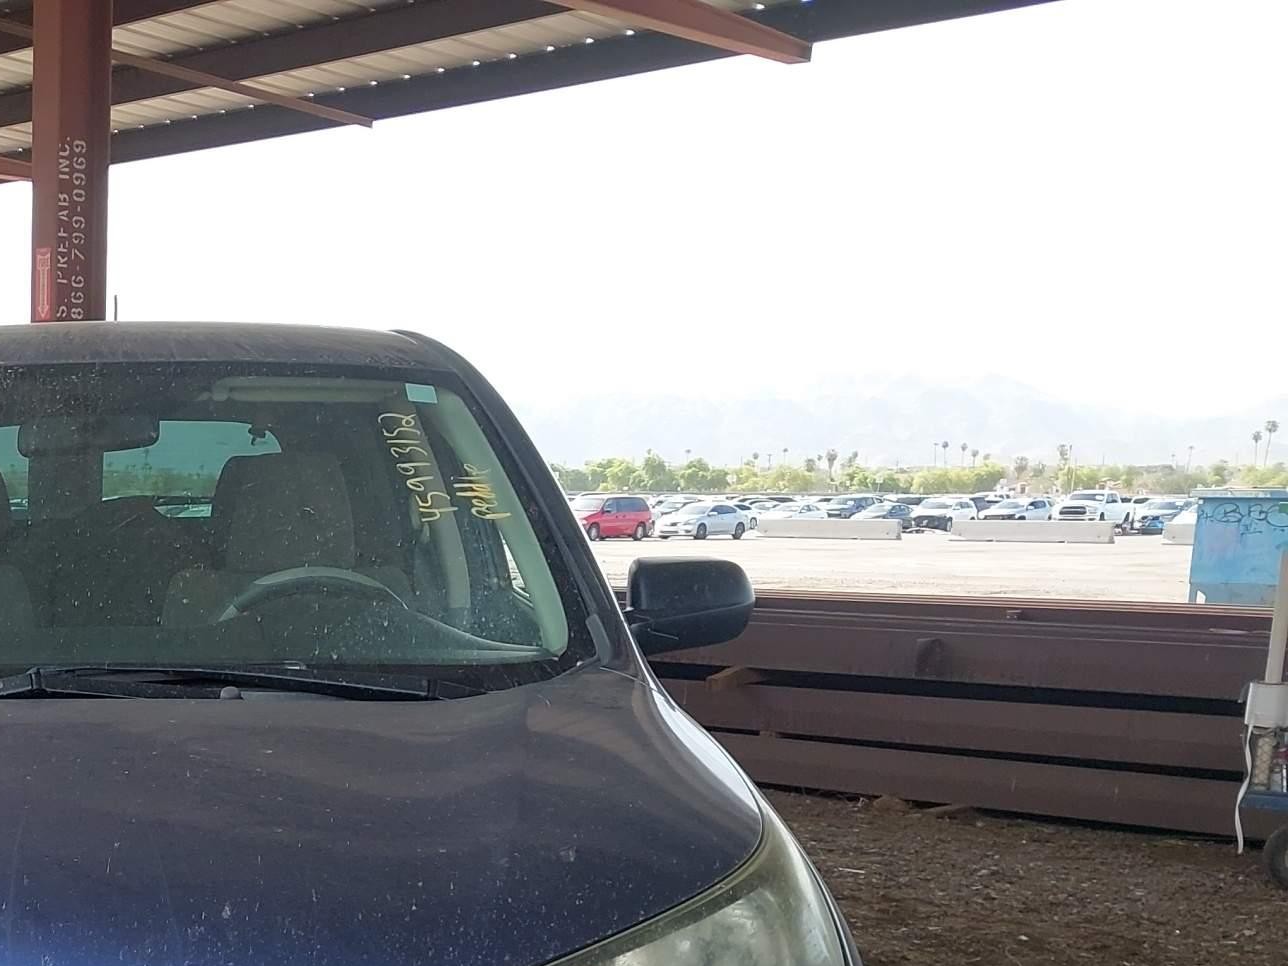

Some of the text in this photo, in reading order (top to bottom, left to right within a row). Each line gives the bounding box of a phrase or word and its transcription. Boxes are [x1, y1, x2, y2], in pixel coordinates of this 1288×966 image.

[58, 136, 72, 180] INC.
[56, 193, 70, 284] PREFAB
[70, 139, 88, 320] 866-799-0969
[377, 412, 459, 523] 45993152
